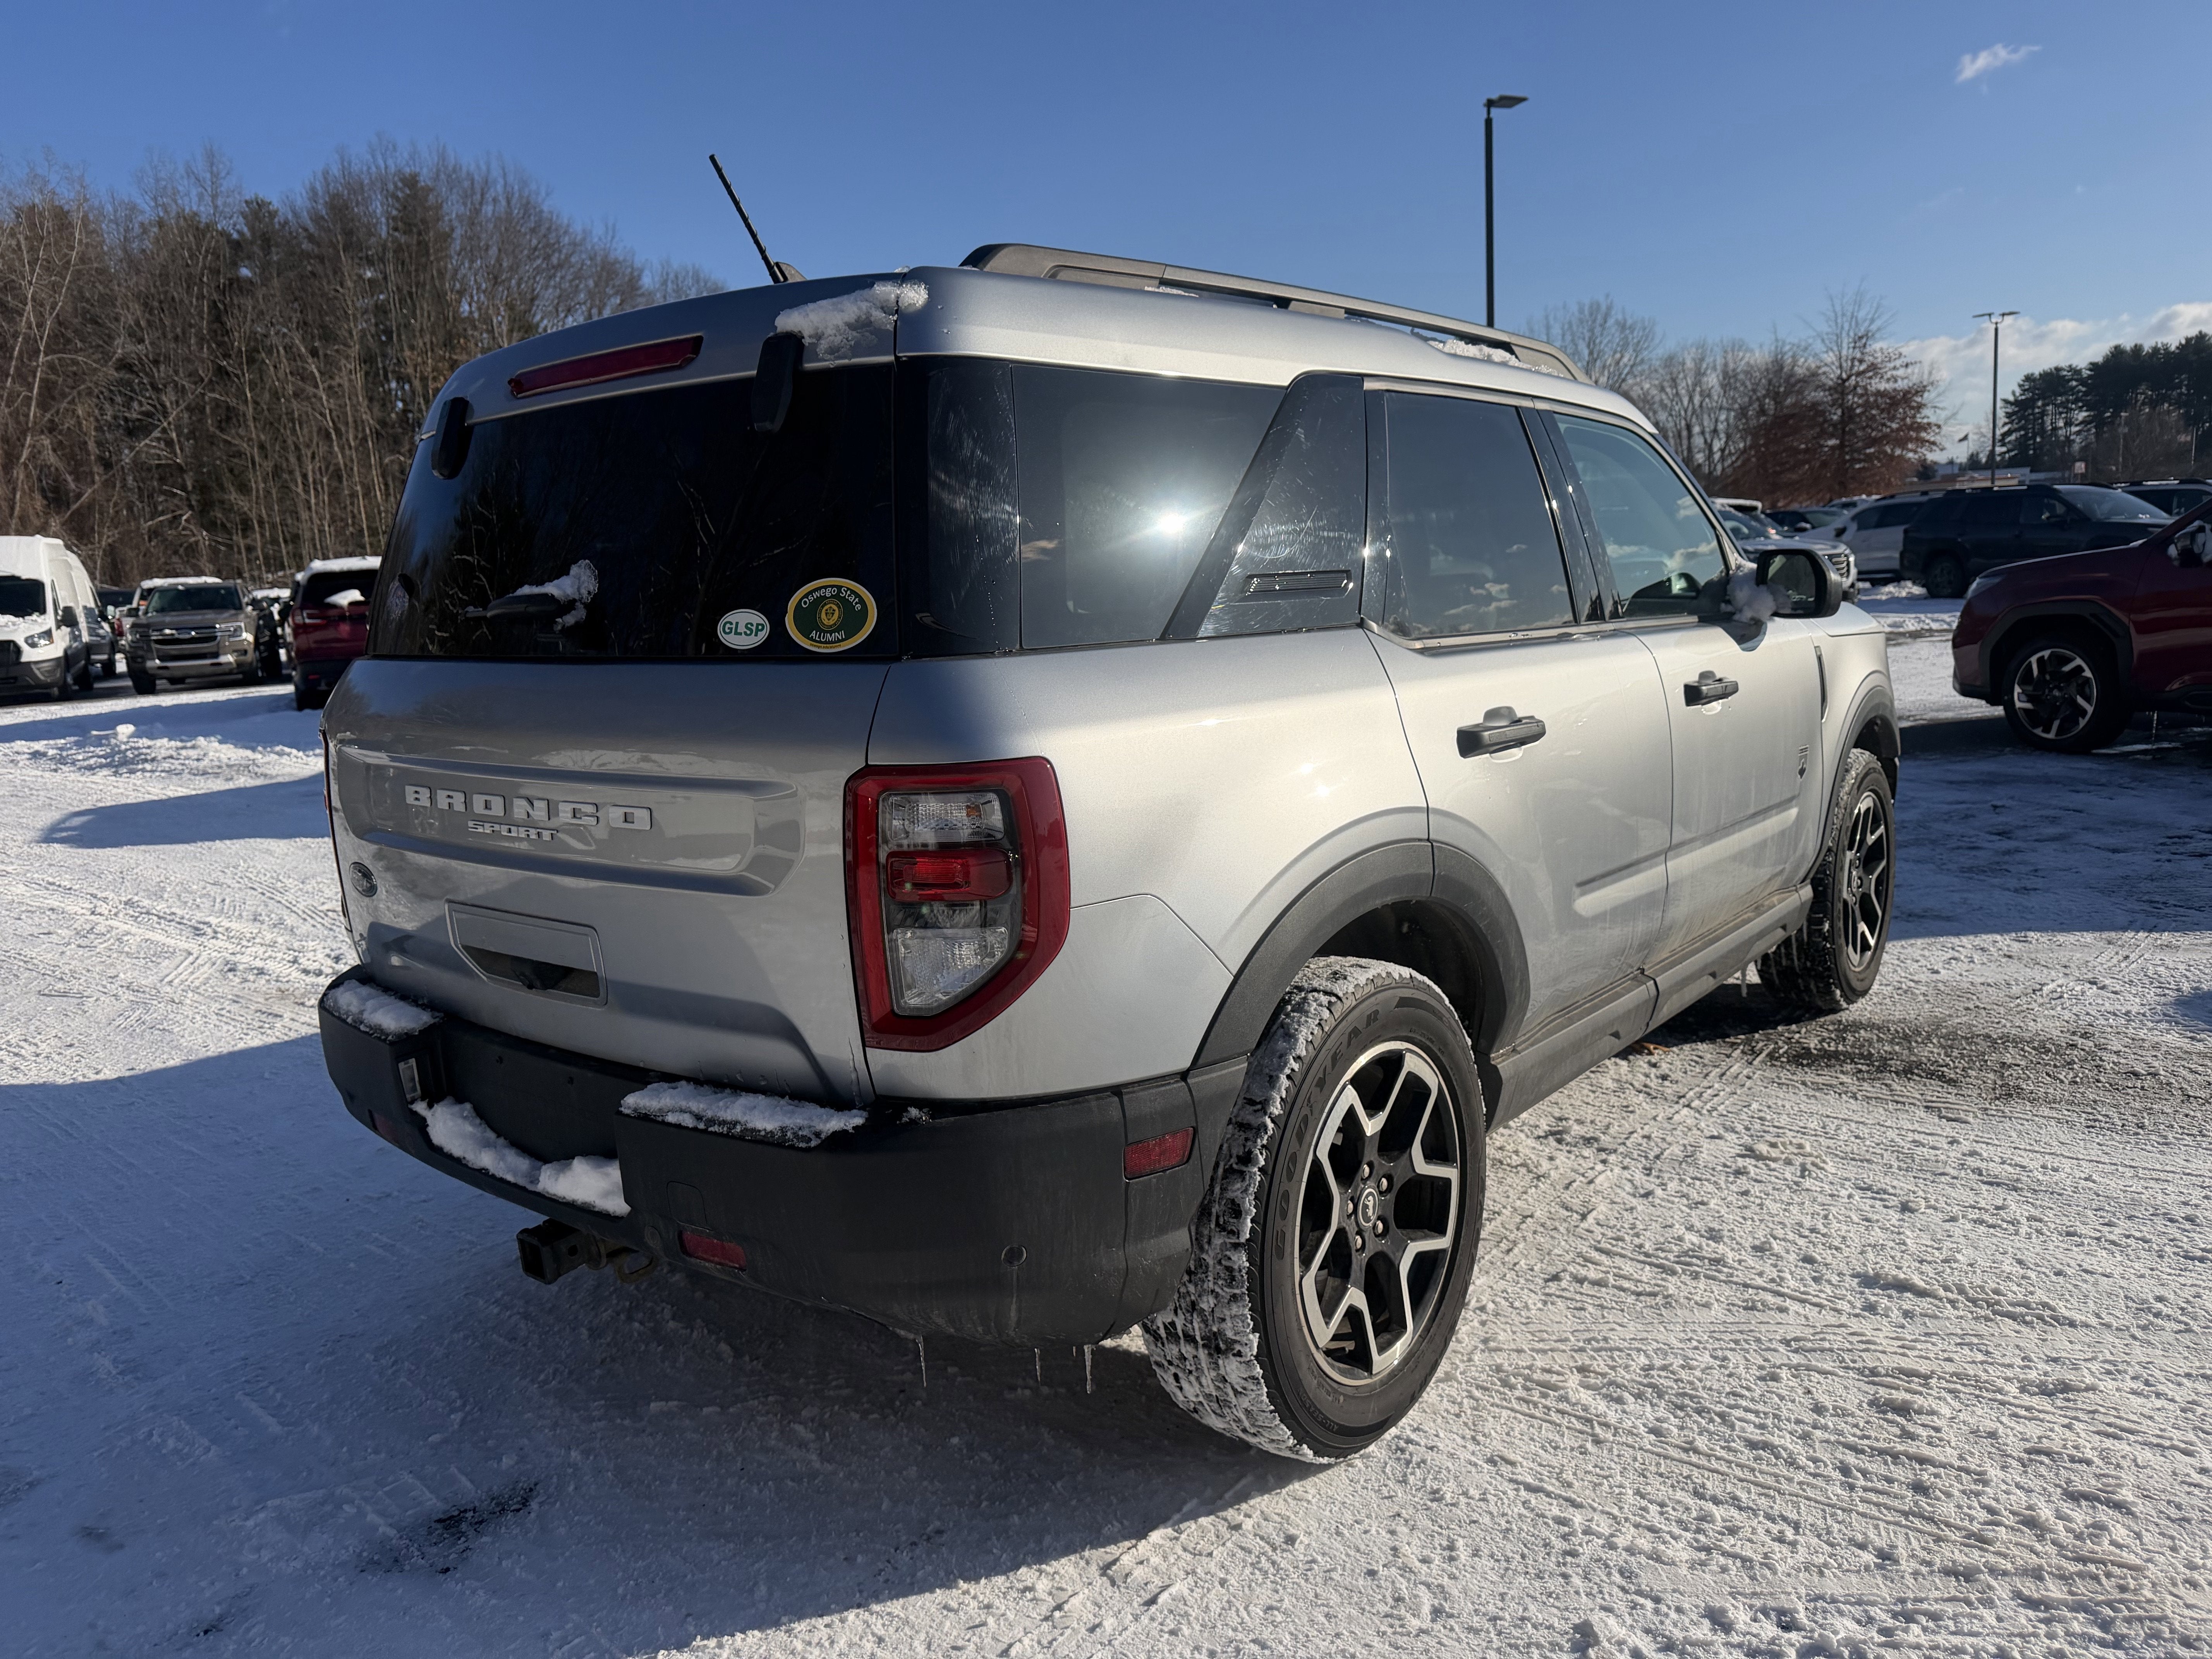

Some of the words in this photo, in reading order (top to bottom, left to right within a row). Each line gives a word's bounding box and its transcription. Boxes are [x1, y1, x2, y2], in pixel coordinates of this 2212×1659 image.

[802, 587, 837, 608] Oswego
[840, 587, 862, 611] State
[722, 621, 765, 637] GLSP
[809, 630, 845, 642] ALUMNI
[405, 785, 653, 830] BRONCO
[468, 819, 558, 841] SPORT
